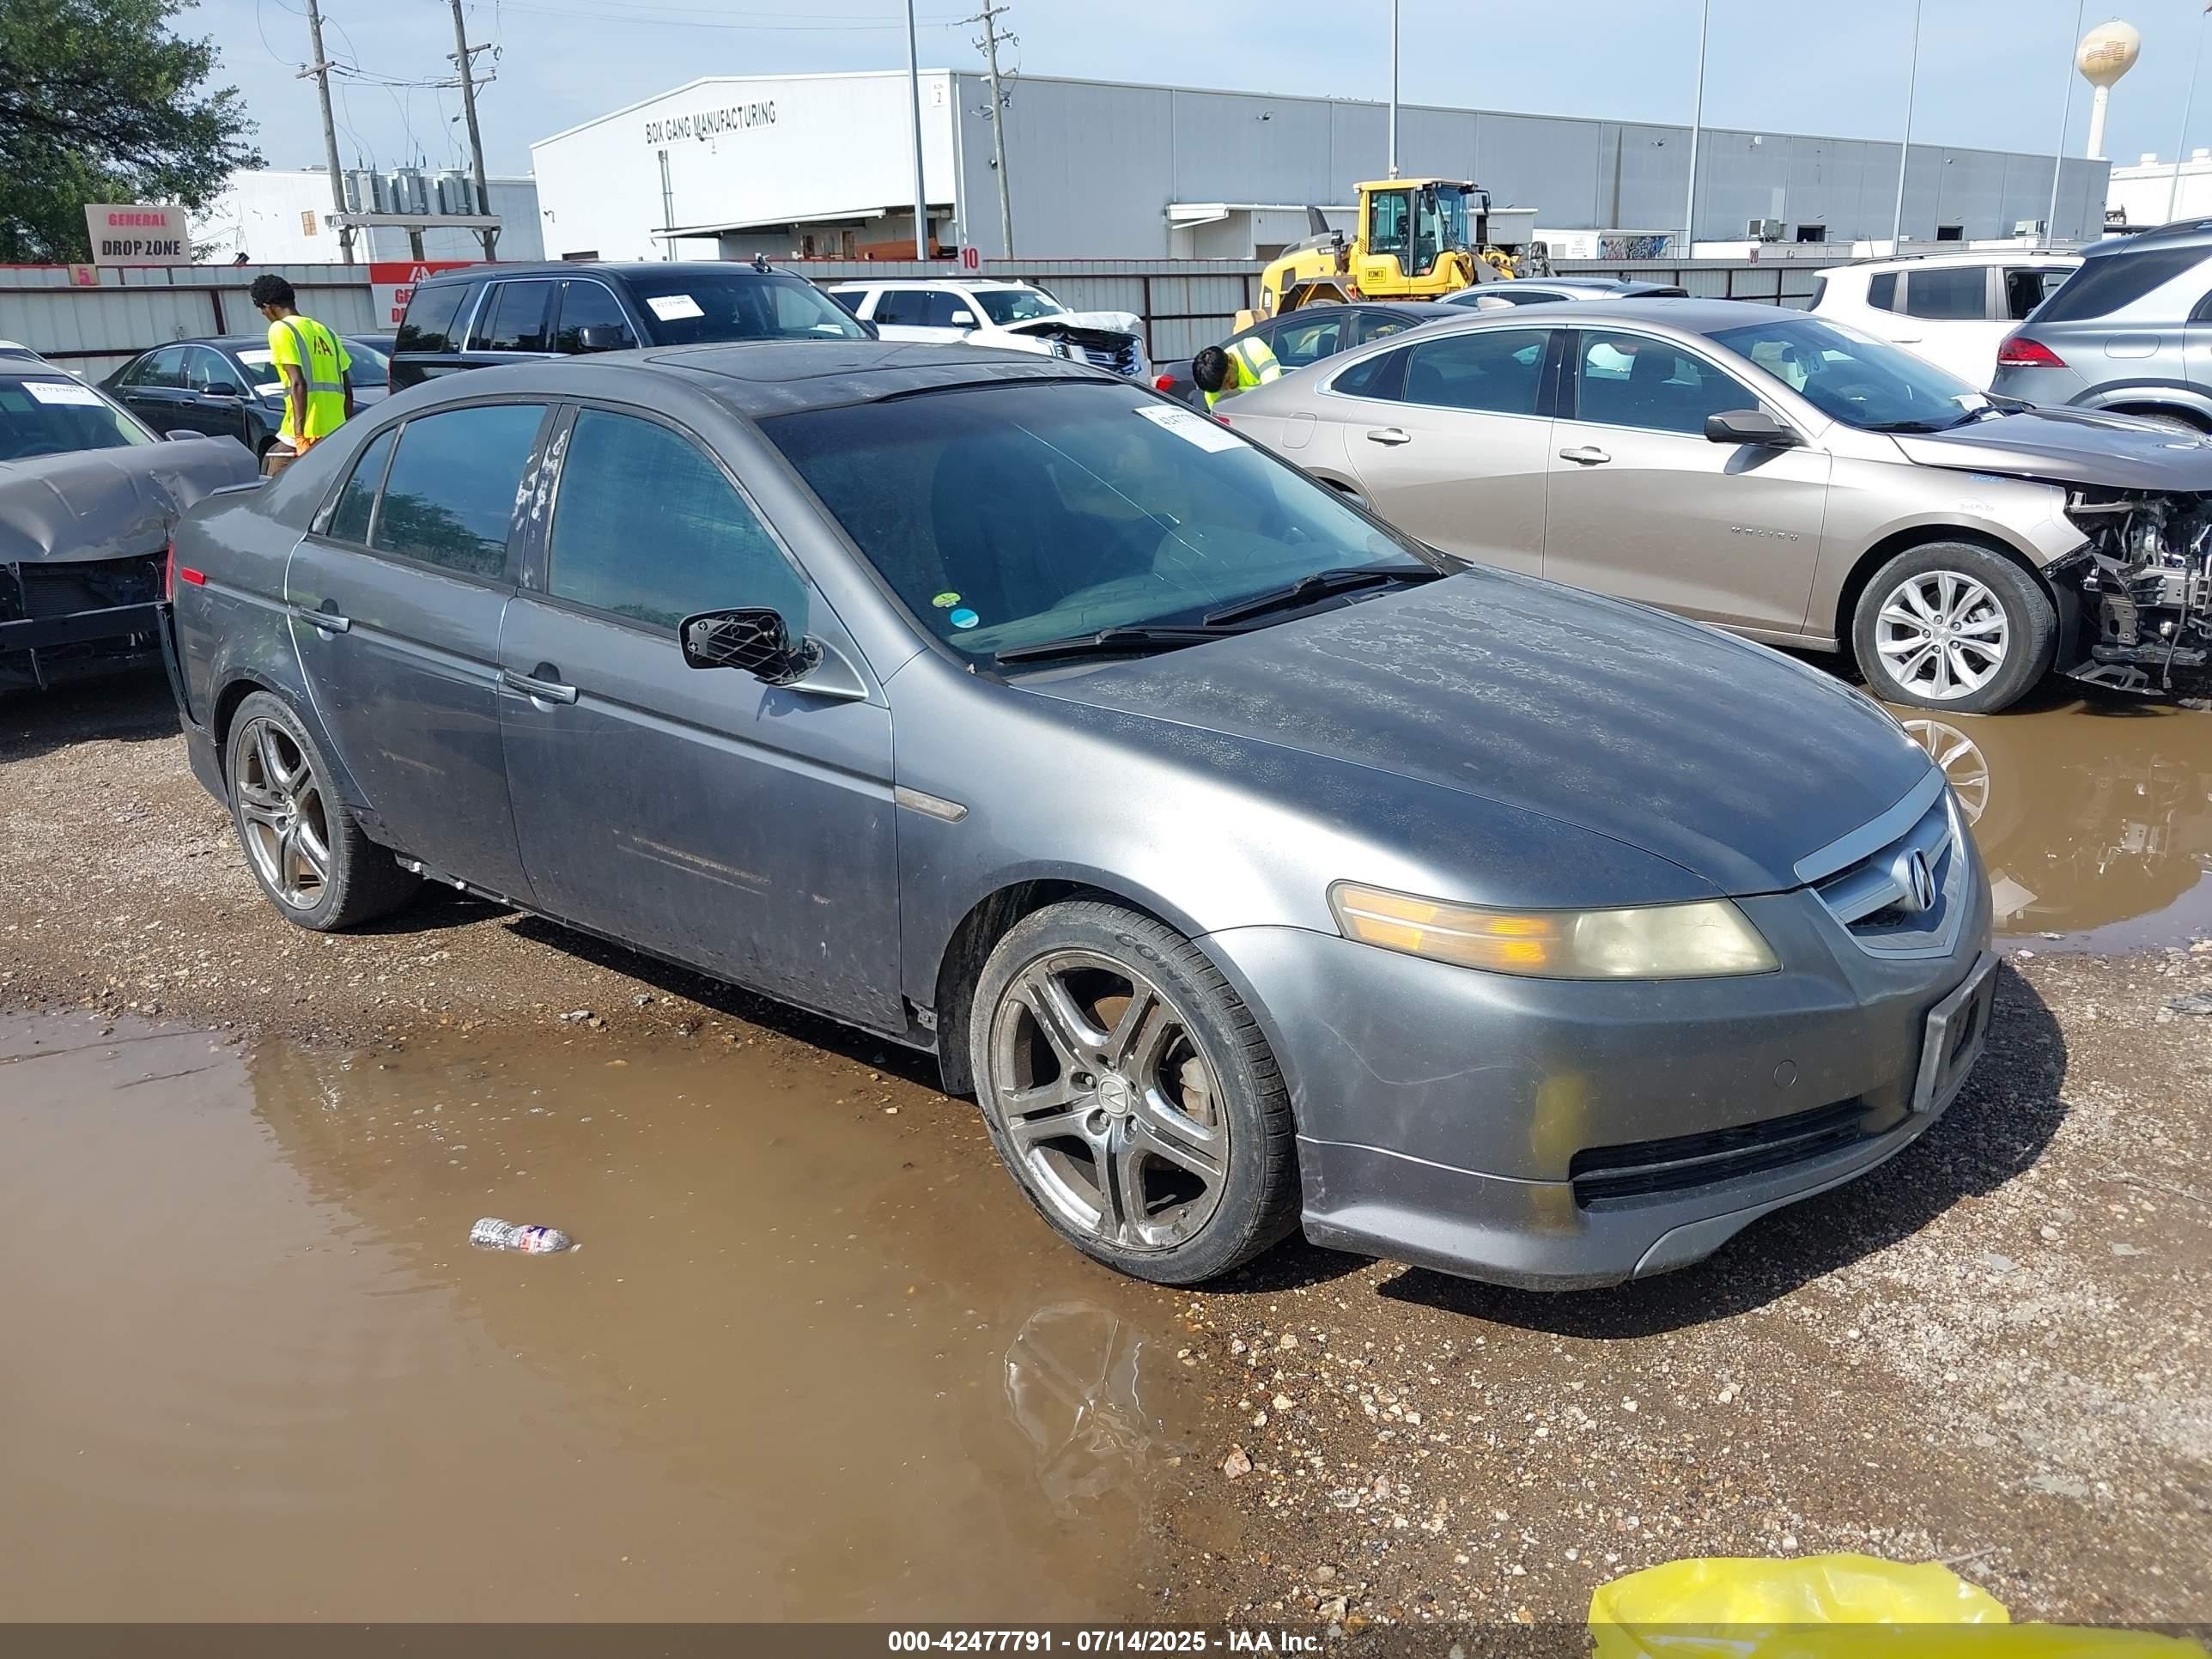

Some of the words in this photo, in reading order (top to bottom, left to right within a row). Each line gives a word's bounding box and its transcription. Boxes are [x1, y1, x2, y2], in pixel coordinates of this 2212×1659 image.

[646, 123, 665, 144] BOX
[665, 116, 691, 141] GANG
[693, 100, 776, 135] MANUFACTURING
[108, 213, 167, 227] GENERAL
[102, 240, 143, 256] DROP
[145, 240, 180, 255] ZONE
[961, 247, 979, 269] 10
[1749, 250, 1759, 264] 20
[77, 267, 91, 285] 5
